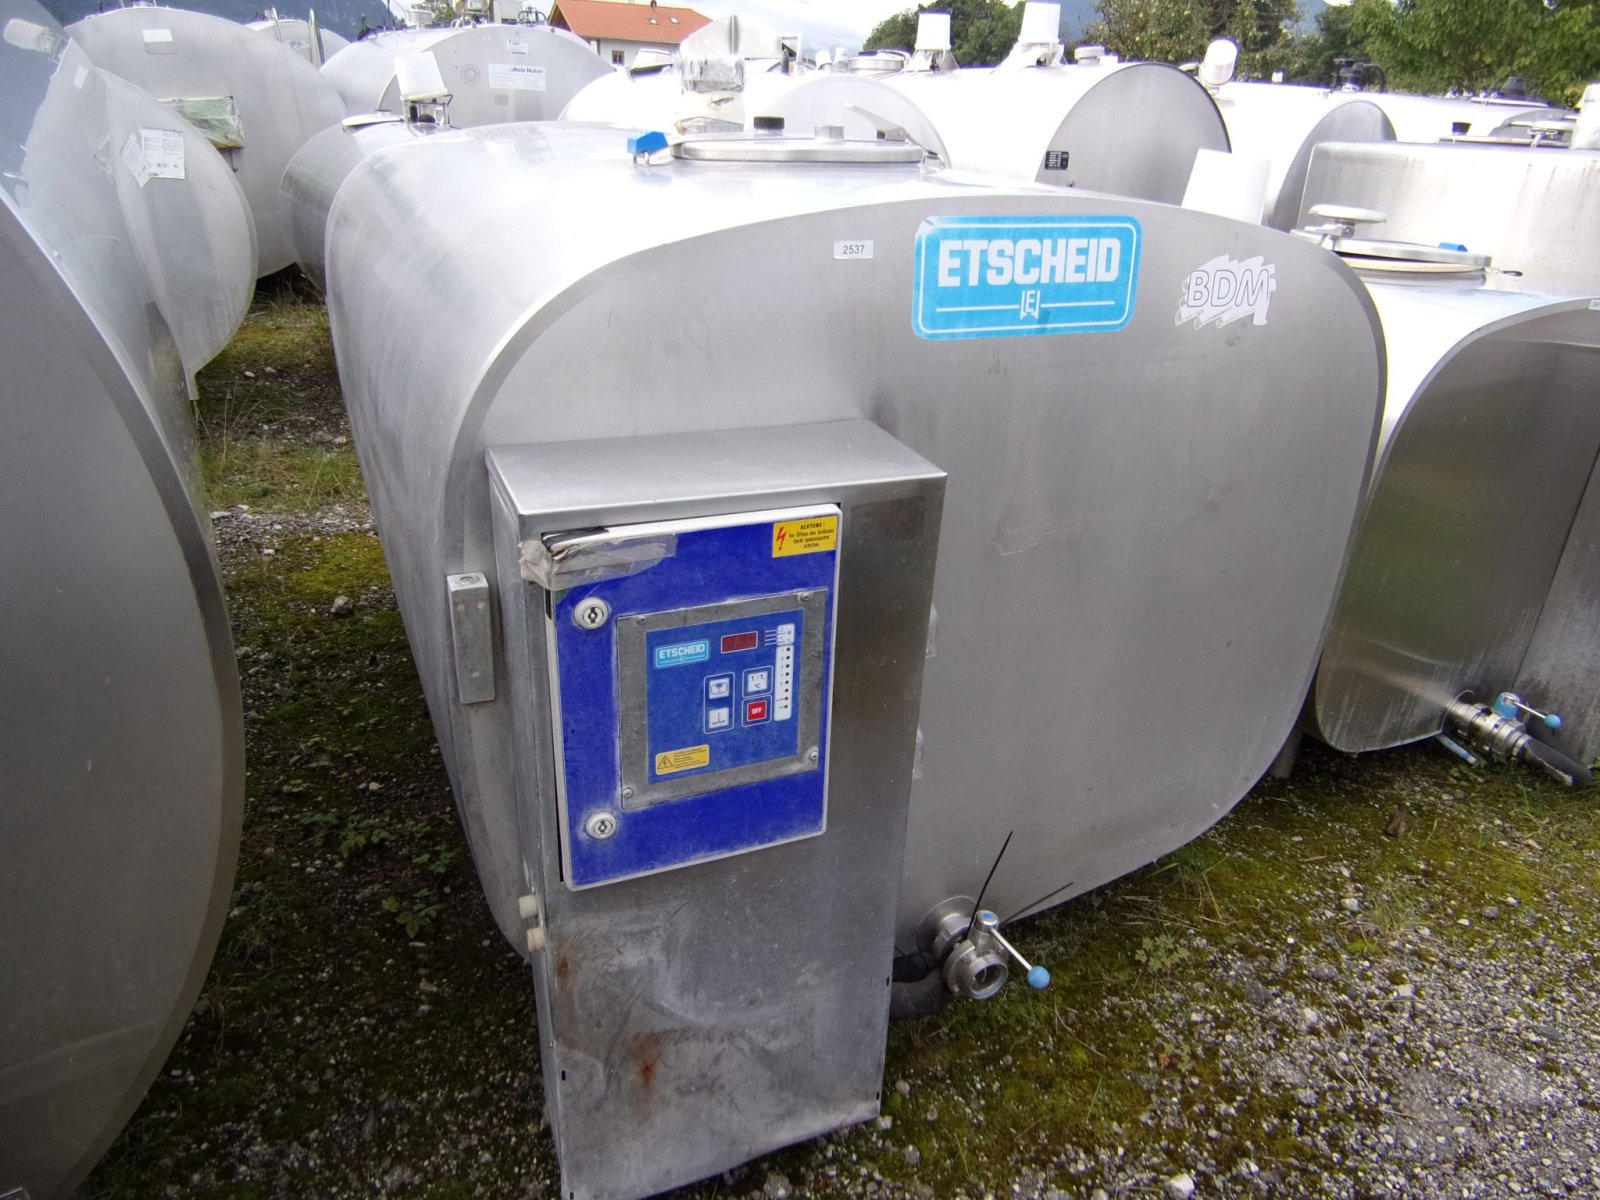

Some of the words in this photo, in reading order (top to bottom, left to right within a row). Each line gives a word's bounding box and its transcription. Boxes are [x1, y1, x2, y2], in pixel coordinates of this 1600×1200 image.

[842, 244, 865, 255] 2537
[938, 238, 1119, 287] ETSCHEID
[1187, 268, 1270, 308] BDM
[659, 643, 705, 659] ETSCHEID
